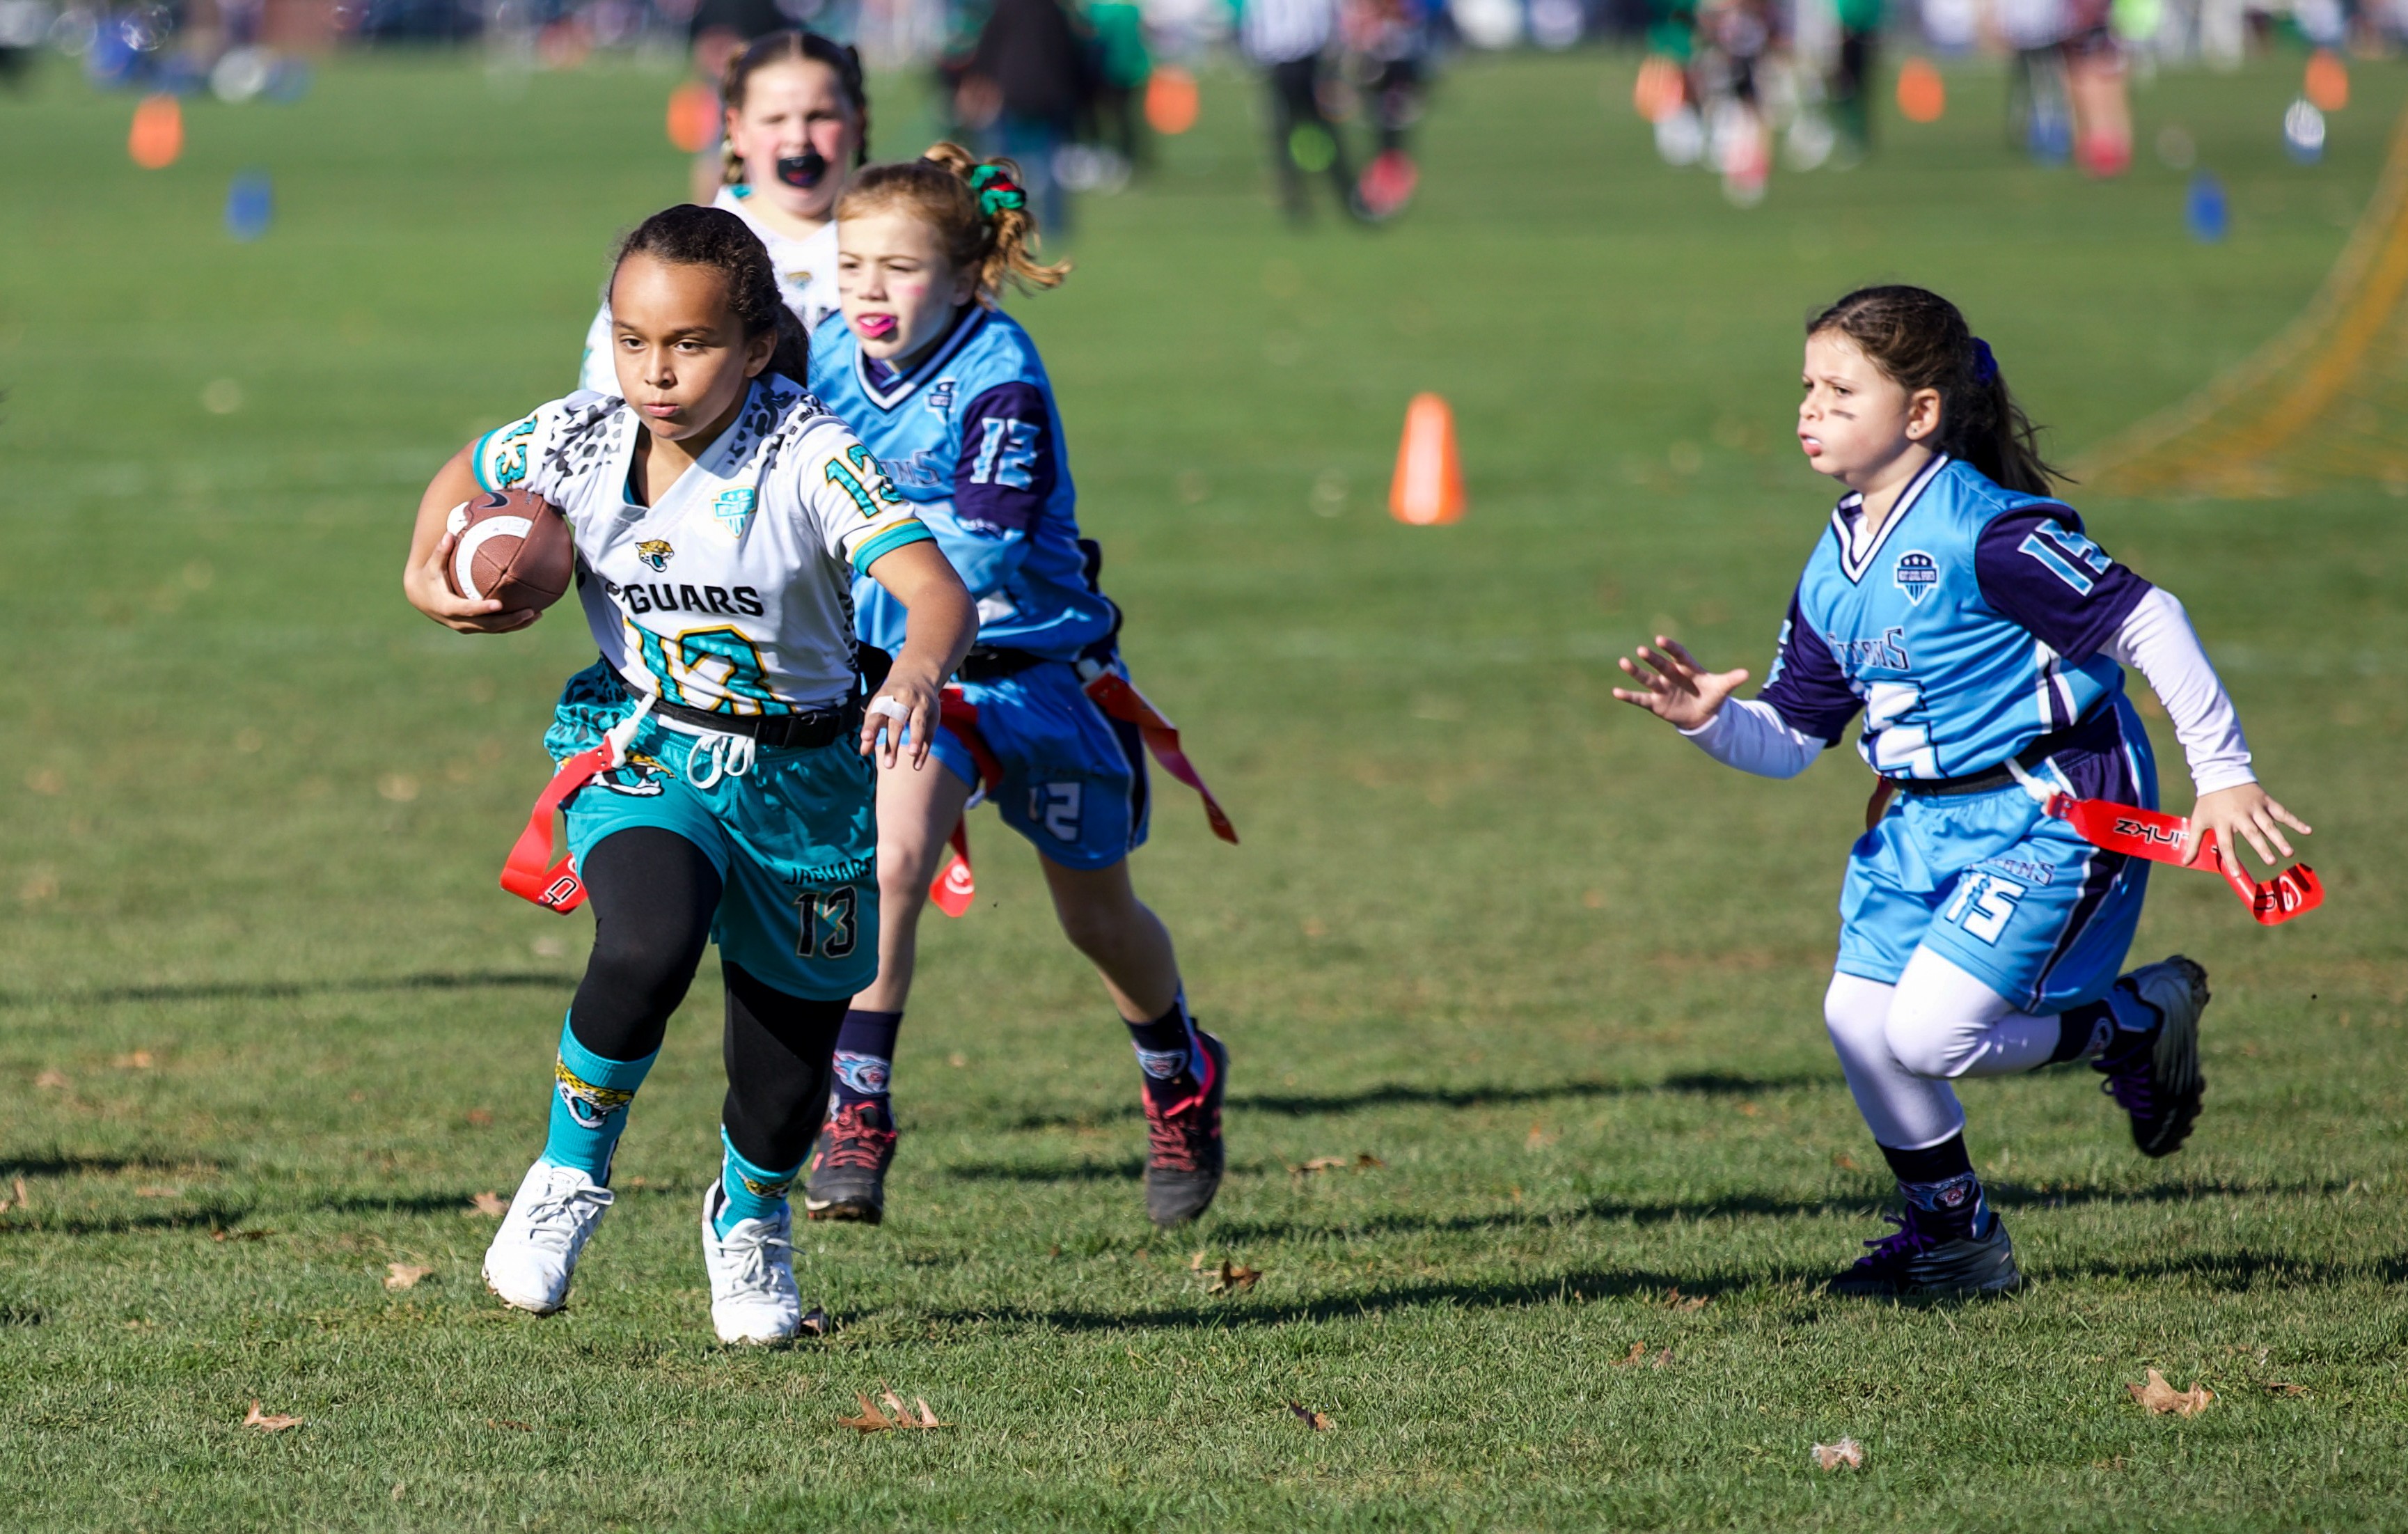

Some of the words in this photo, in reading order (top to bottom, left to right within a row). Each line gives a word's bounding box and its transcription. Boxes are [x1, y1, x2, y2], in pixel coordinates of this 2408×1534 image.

[970, 417, 1041, 492] 12
[622, 584, 764, 617] GUARS
[793, 884, 857, 958] 13
[1944, 870, 2029, 948] 15
